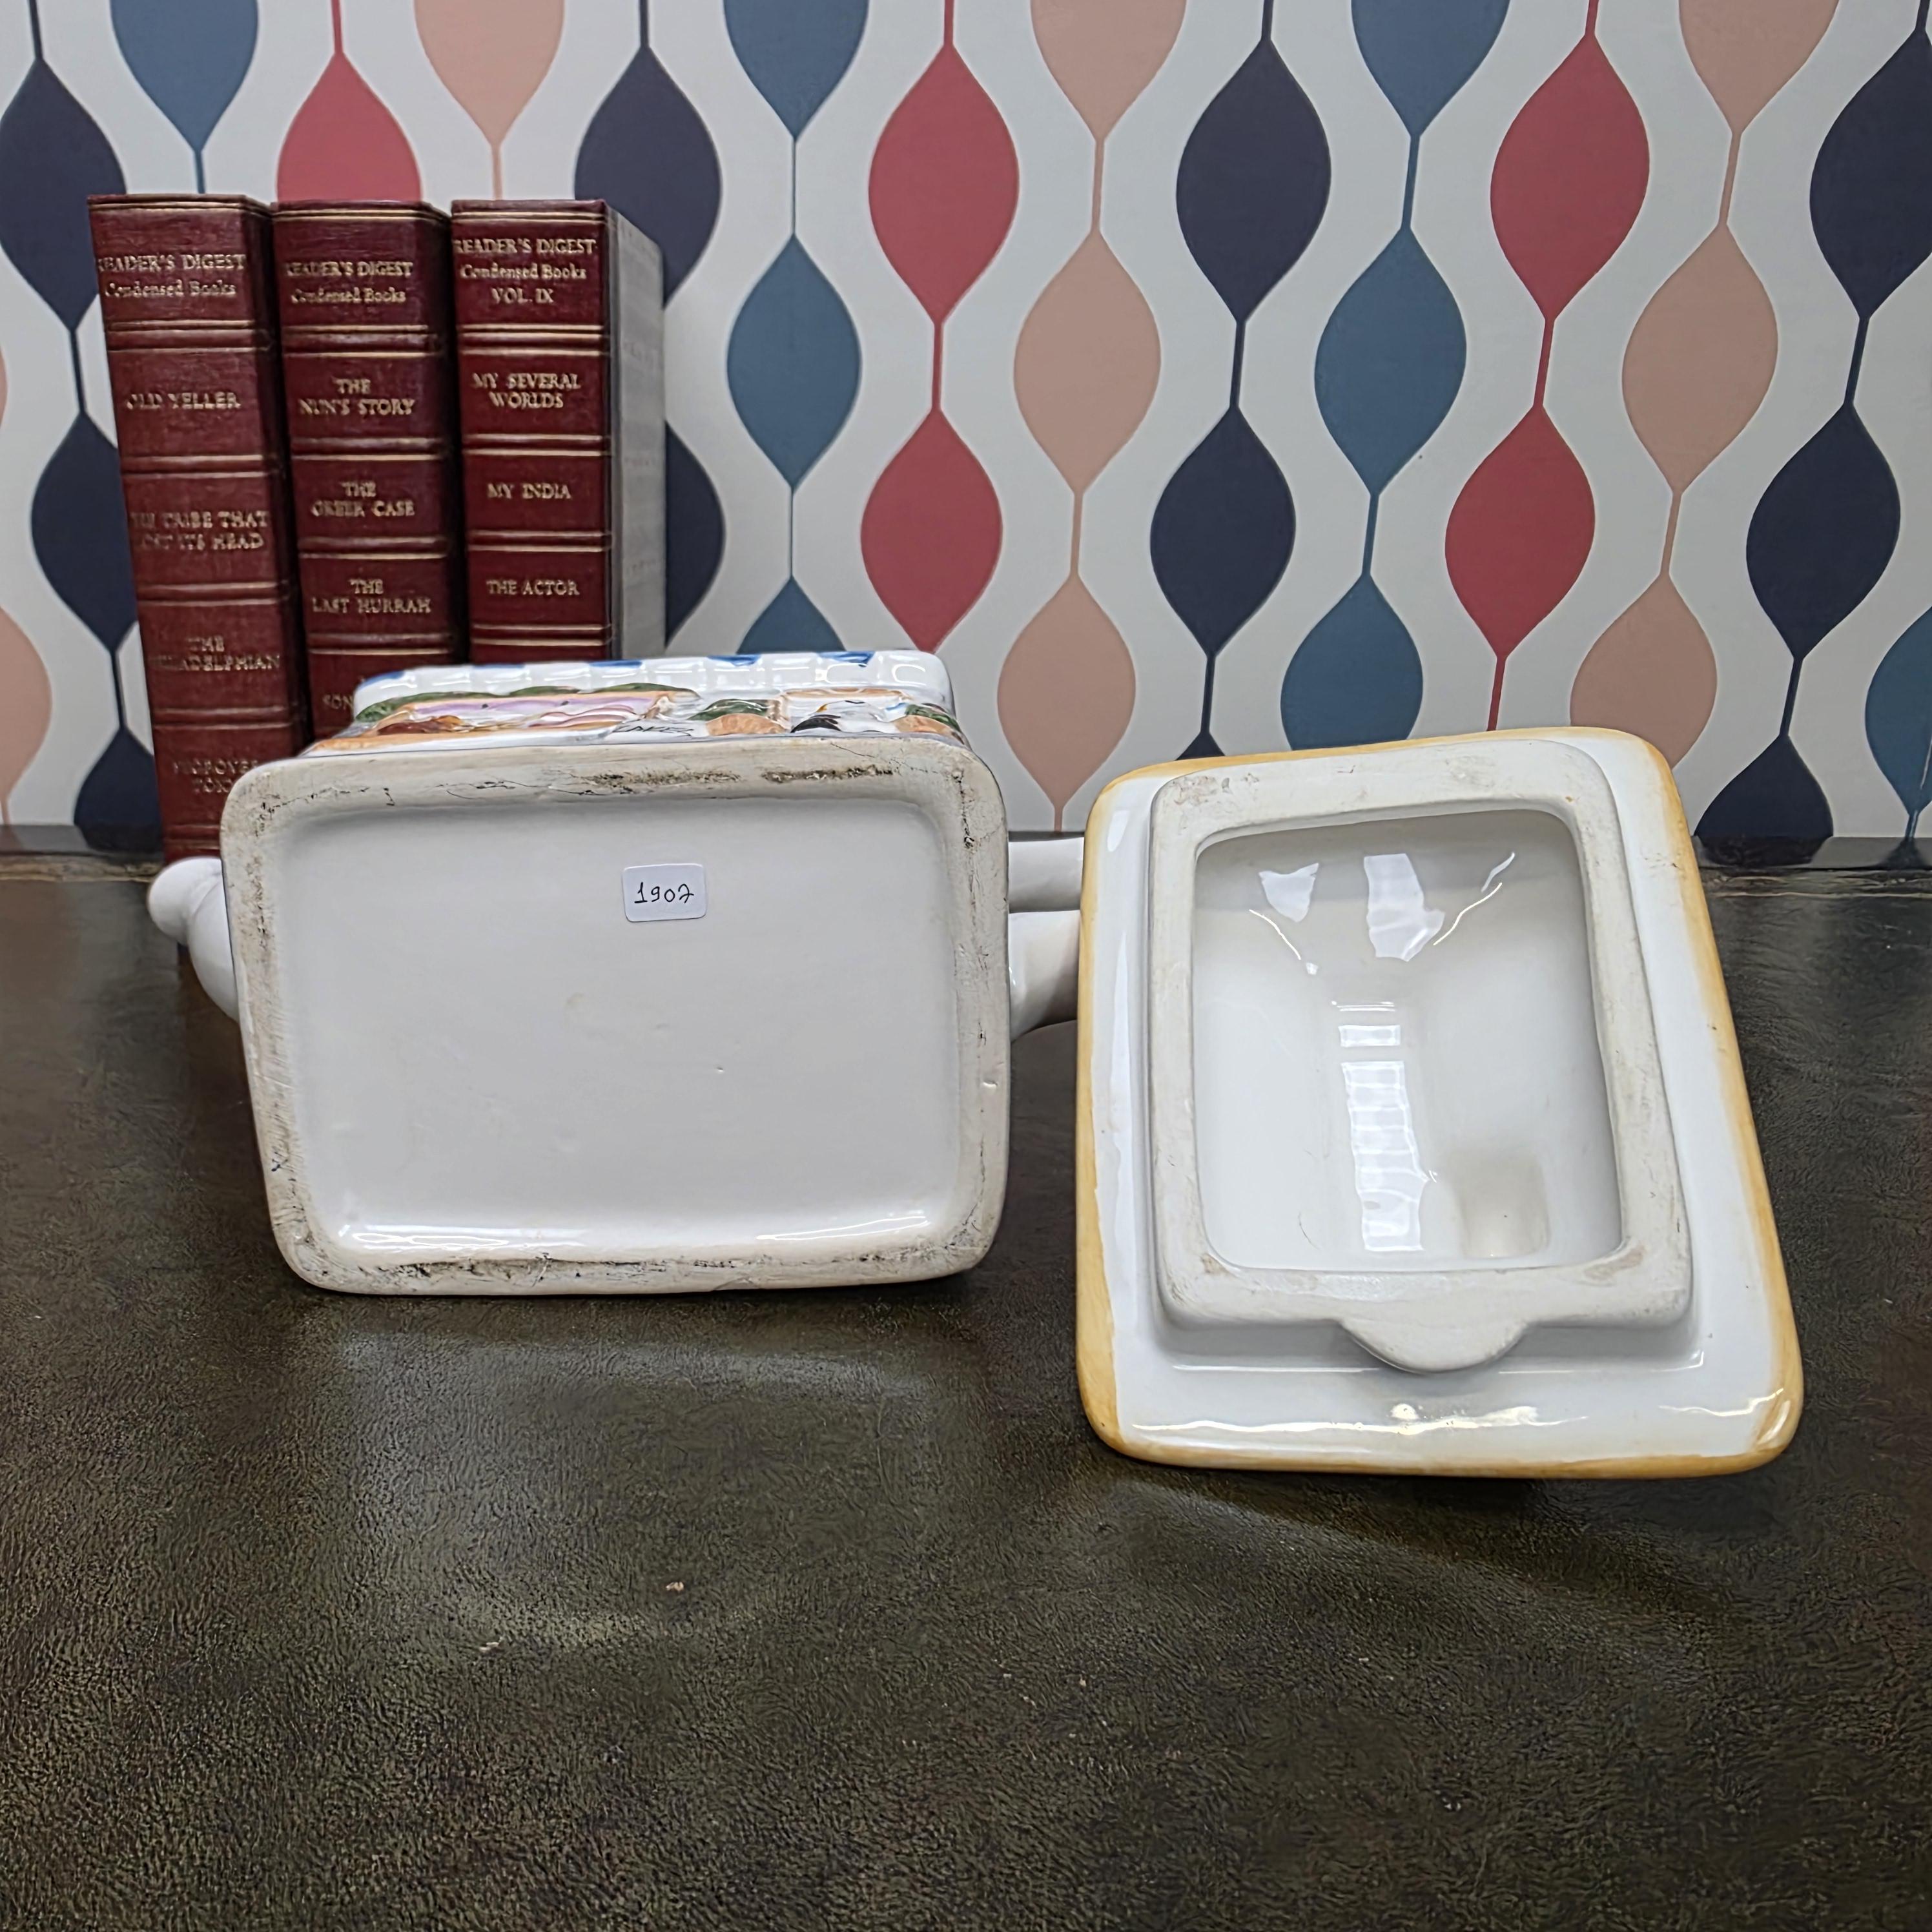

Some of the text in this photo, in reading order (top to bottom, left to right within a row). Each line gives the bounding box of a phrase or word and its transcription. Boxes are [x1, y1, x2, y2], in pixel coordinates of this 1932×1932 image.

[537, 238, 598, 255] DIGEST
[181, 254, 246, 271] DIGEST
[357, 262, 413, 277] DIGEST
[460, 262, 586, 280] Condensed Books
[105, 279, 237, 298] Condensed Books
[364, 287, 406, 303] Books
[491, 287, 555, 304] VOL. IX
[333, 378, 371, 394] THE
[472, 373, 581, 389] MY SEVERAL
[168, 391, 241, 409] YELLER
[358, 398, 415, 415] STORY
[489, 391, 564, 409] WORLDS
[339, 481, 376, 497] THE
[487, 483, 571, 499] MY INDIA
[371, 500, 415, 517] CASE
[218, 510, 267, 528] THAT
[350, 579, 384, 594] THE
[486, 581, 580, 595] THE ACTOR
[313, 597, 431, 613] LAST HURRAH
[634, 881, 695, 903] 1907
